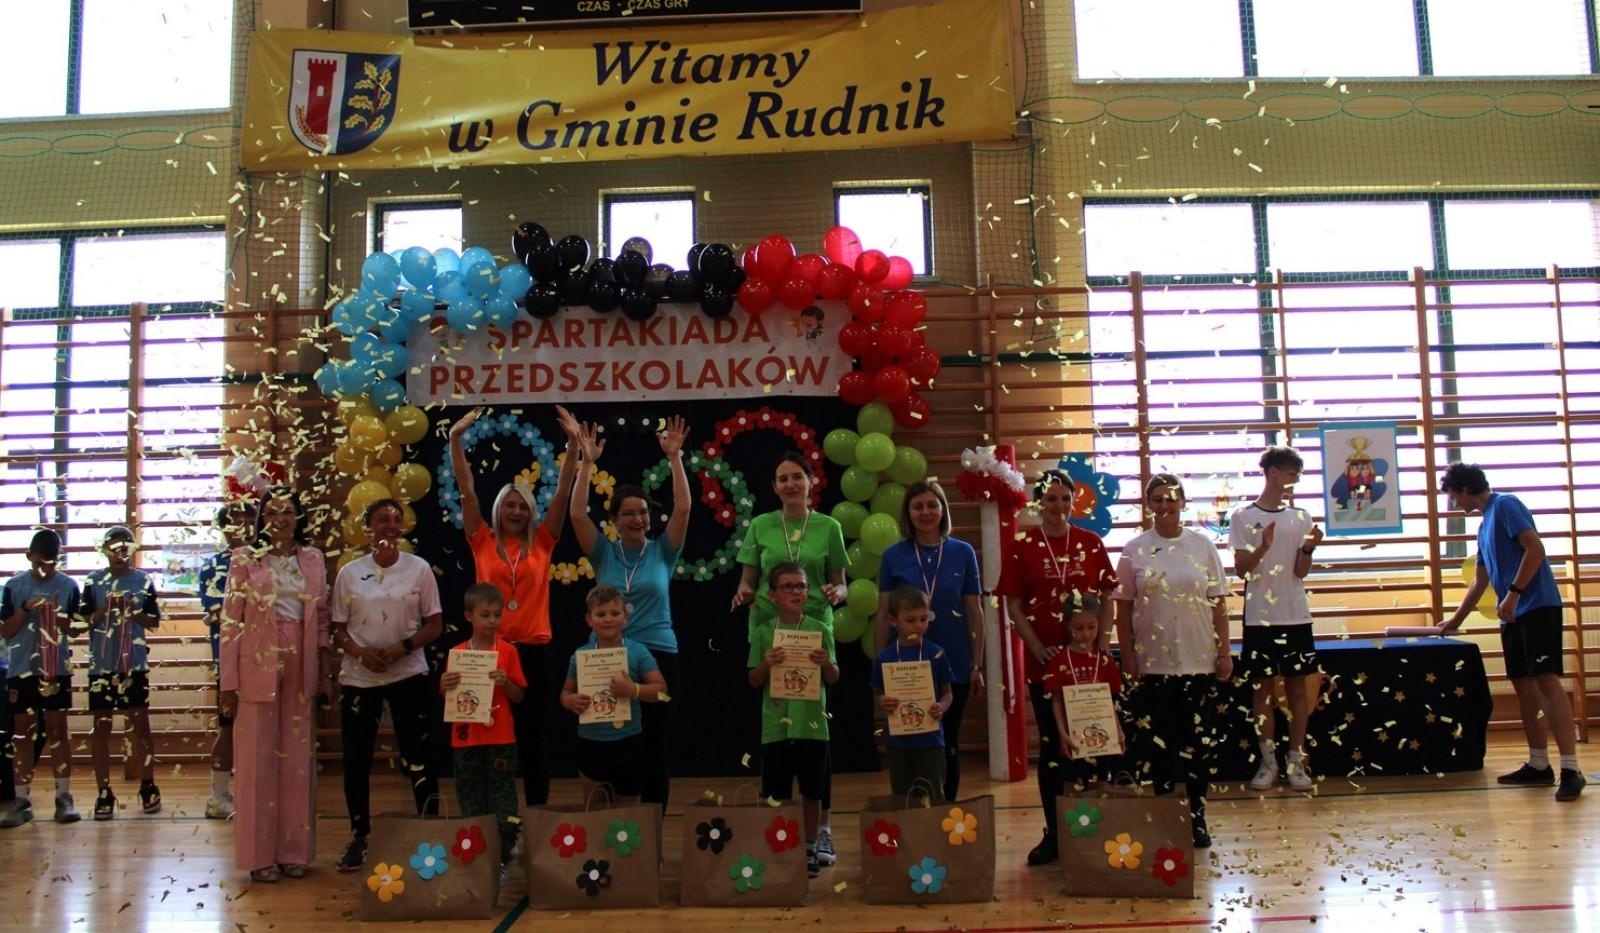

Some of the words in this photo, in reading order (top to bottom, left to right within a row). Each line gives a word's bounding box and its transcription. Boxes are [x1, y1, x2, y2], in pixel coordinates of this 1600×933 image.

[577, 1, 610, 12] CZAS
[627, 0, 661, 9] CZAS
[664, 0, 690, 8] GRY
[592, 42, 810, 87] Witamy
[447, 118, 494, 154] w
[516, 99, 717, 151] Gminie
[736, 78, 945, 140] Rudnik
[488, 316, 769, 349] SPARTAKIADA
[428, 346, 829, 395] PRZEDSZKOLAKÓW
